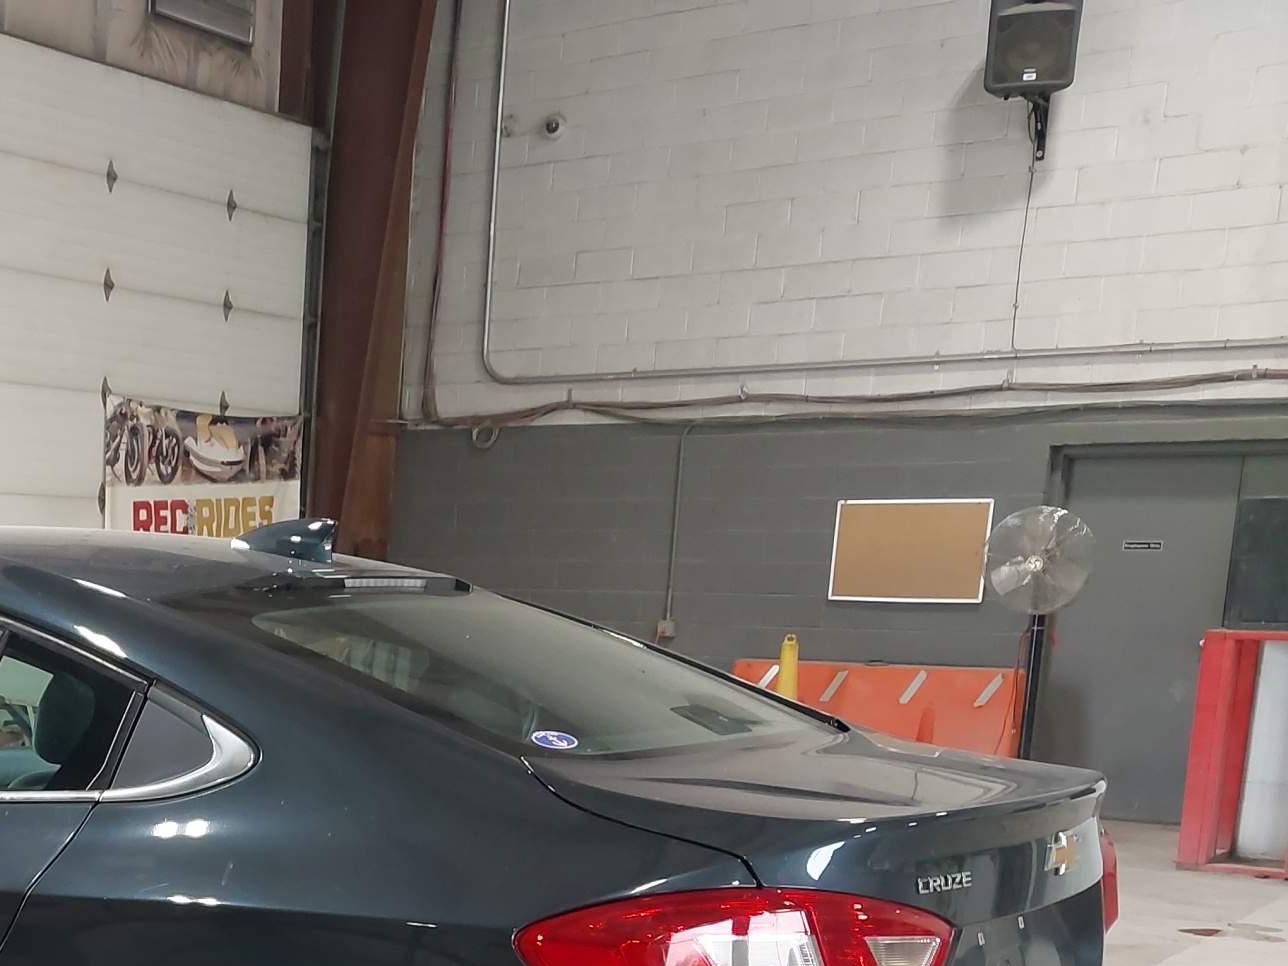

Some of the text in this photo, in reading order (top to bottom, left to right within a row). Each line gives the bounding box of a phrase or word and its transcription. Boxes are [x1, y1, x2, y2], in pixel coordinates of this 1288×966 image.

[133, 496, 274, 538] REC RIDES
[917, 871, 972, 895] CRUZE
